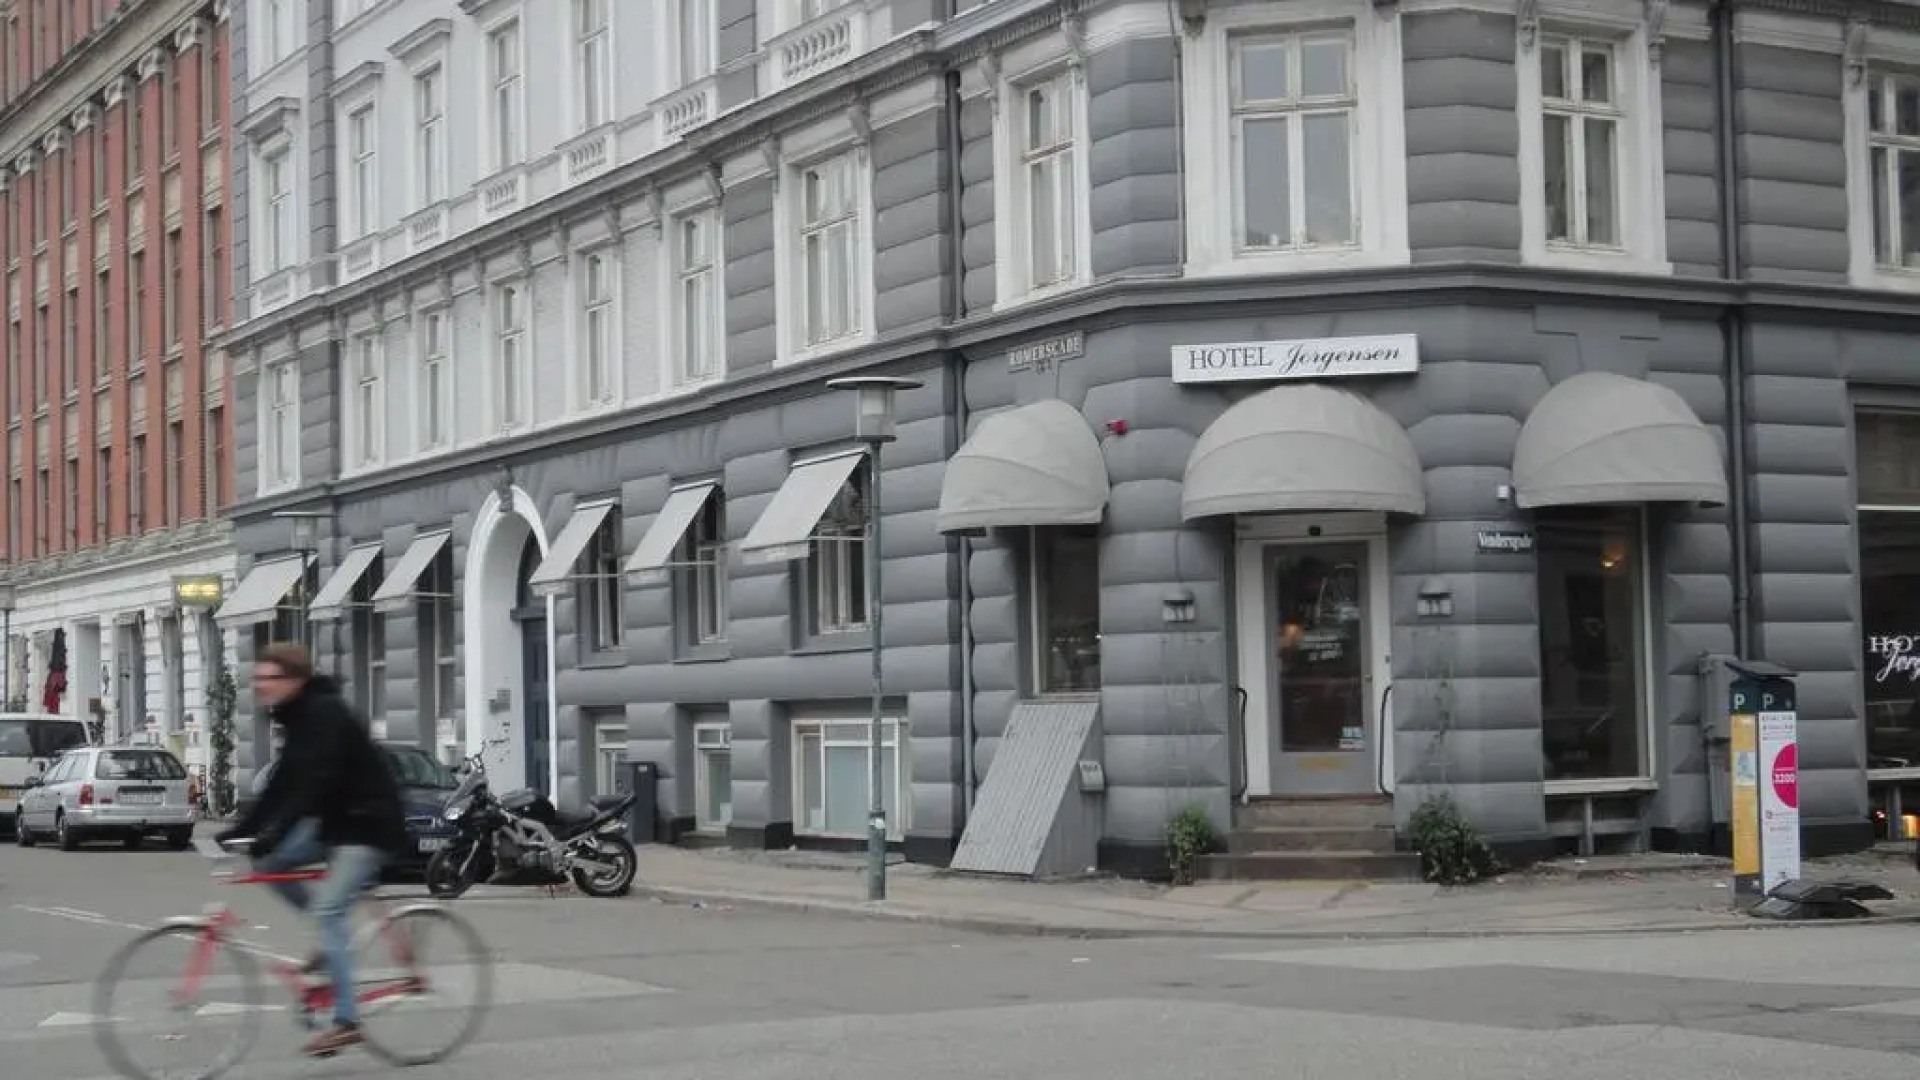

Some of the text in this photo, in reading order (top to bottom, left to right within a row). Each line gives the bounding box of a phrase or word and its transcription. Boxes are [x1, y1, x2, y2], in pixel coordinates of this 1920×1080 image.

[1189, 346, 1272, 370] HOTEL
[1733, 693, 1745, 710] P
[1762, 693, 1774, 710] P
